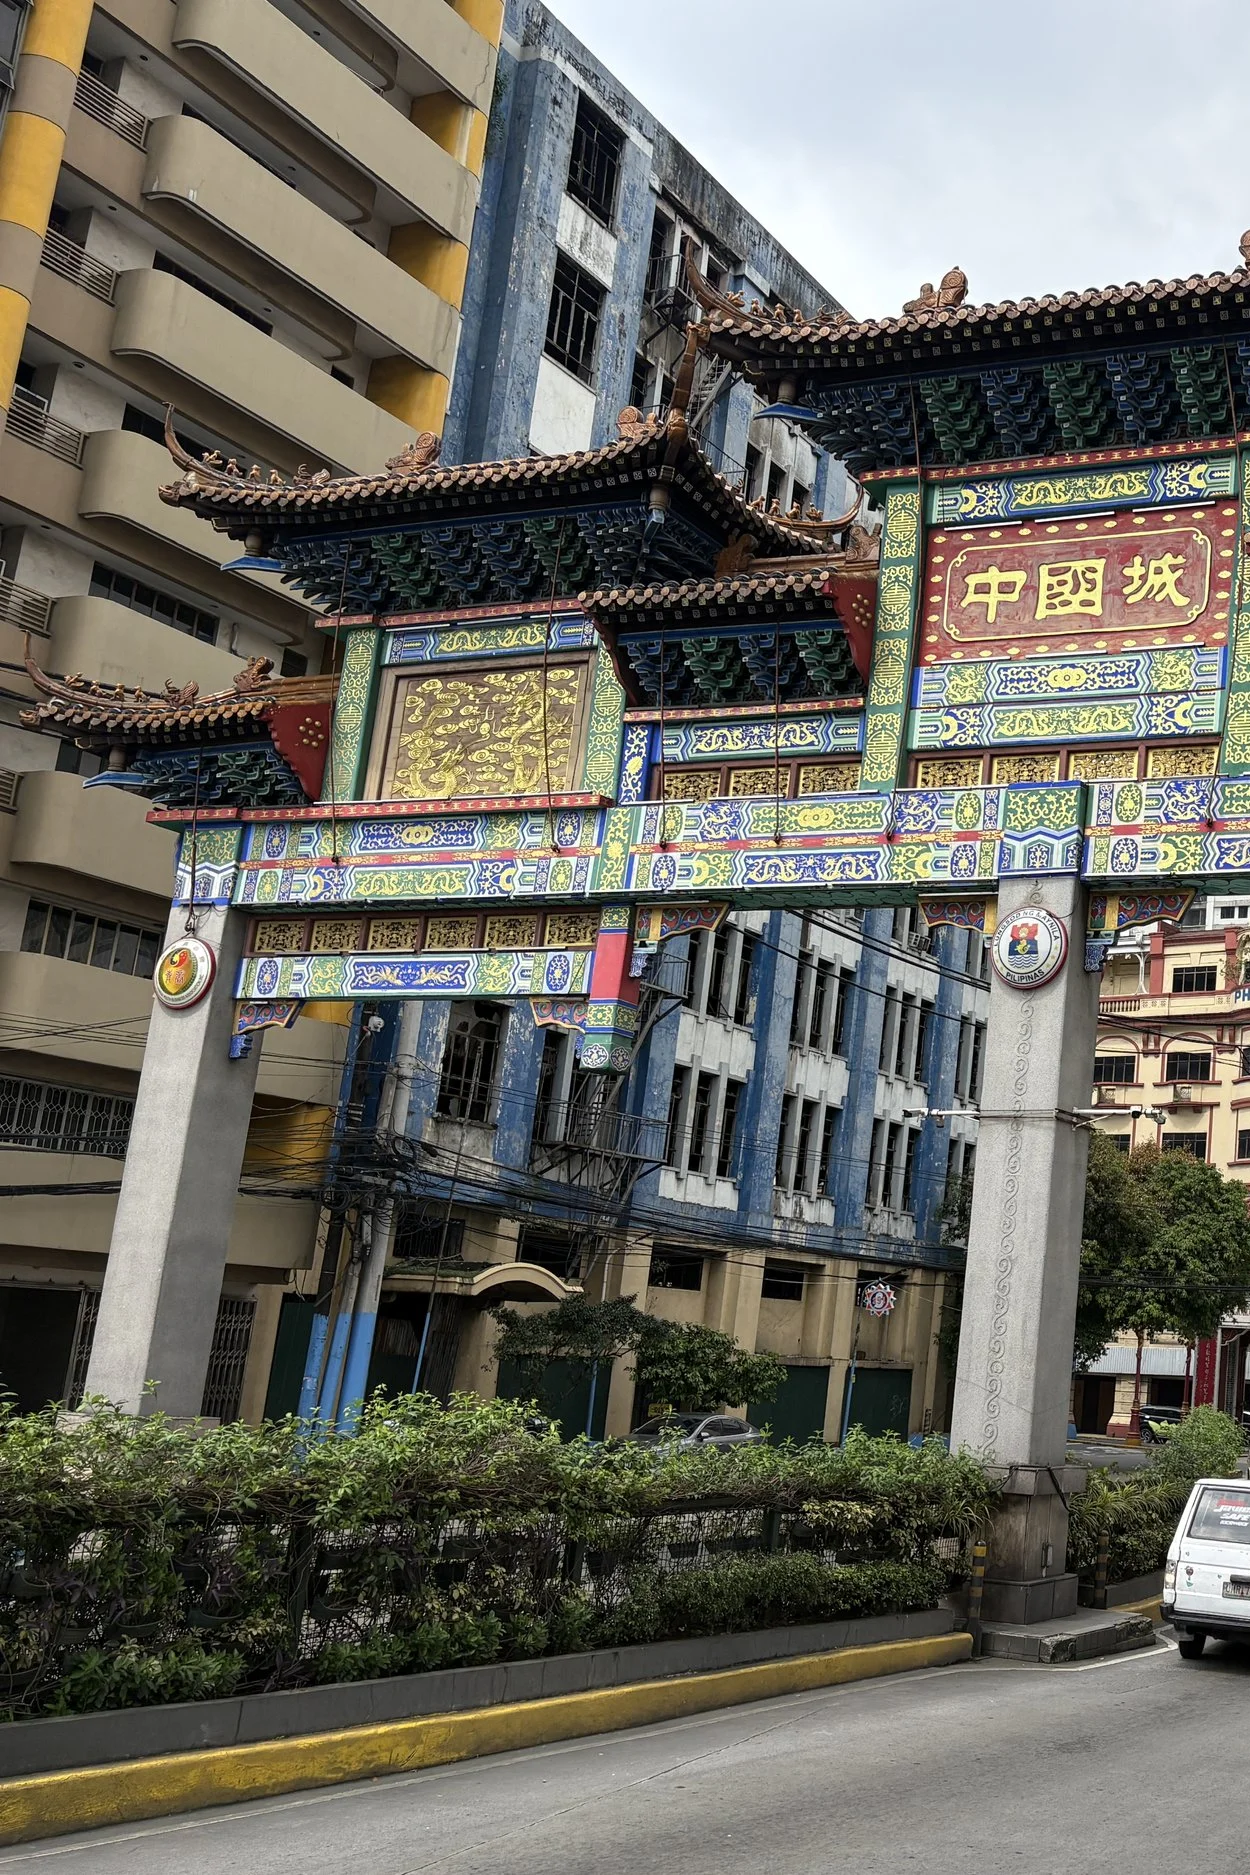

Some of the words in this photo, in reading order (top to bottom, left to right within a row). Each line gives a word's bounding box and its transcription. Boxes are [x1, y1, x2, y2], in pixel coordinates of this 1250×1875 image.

[960, 551, 1191, 624] 中國城
[1005, 969, 1046, 983] PILIPINAS
